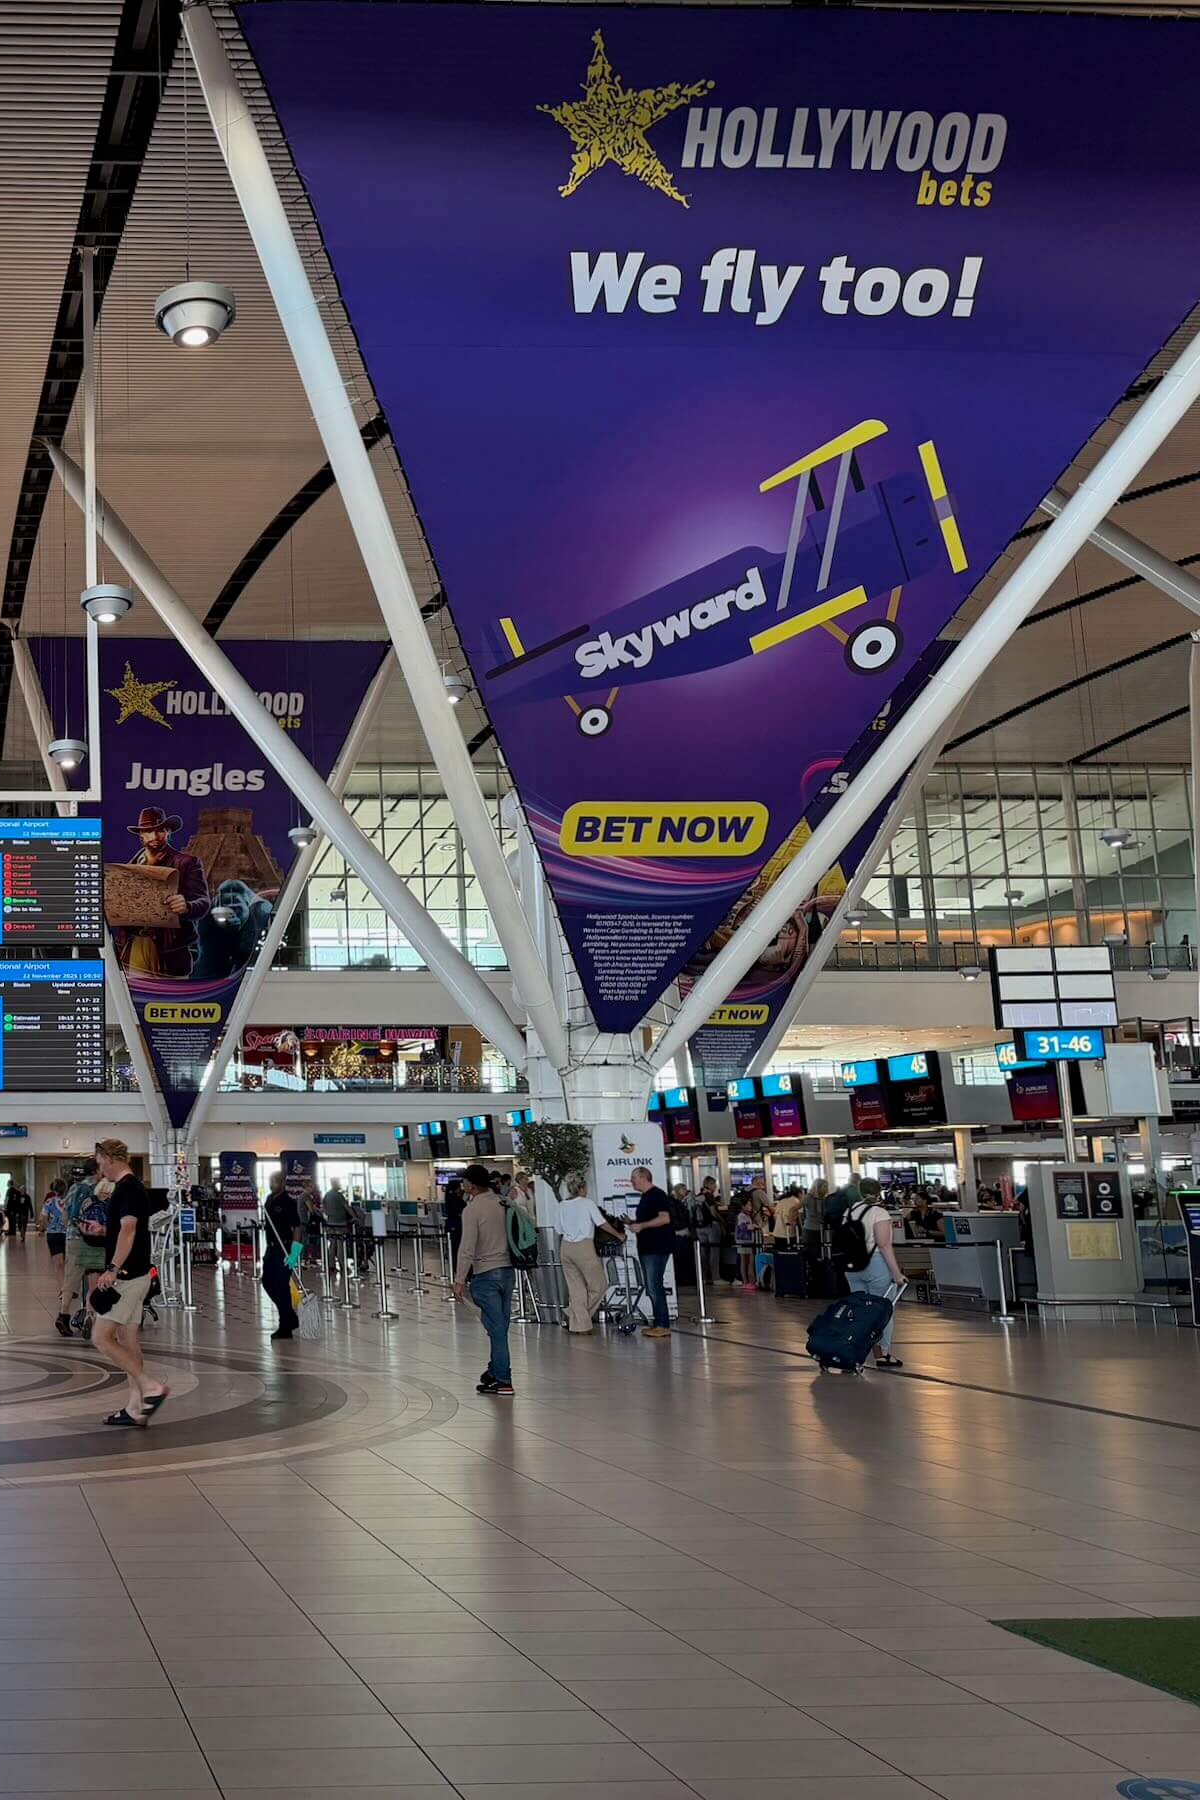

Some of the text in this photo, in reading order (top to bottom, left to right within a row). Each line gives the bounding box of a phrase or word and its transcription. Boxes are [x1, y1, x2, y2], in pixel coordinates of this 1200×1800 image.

[680, 106, 1008, 174] HOLLYWOOD
[916, 171, 993, 207] bets
[570, 247, 984, 326] We fly too!
[573, 567, 768, 679] Skyward
[278, 716, 302, 729] ets
[126, 762, 266, 797] Jungles
[574, 815, 754, 844] BET NOW
[23, 963, 50, 971] Airport
[149, 1008, 216, 1018] BET NOW
[728, 1009, 764, 1020] NOW
[1037, 1035, 1092, 1053] 31-46
[998, 1046, 1017, 1065] 46
[910, 1055, 928, 1074] 45
[843, 1066, 857, 1082] 44
[727, 1082, 739, 1097] 42
[778, 1075, 792, 1092] 43
[678, 1089, 688, 1103] 41
[606, 1158, 653, 1167] AIRLINK
